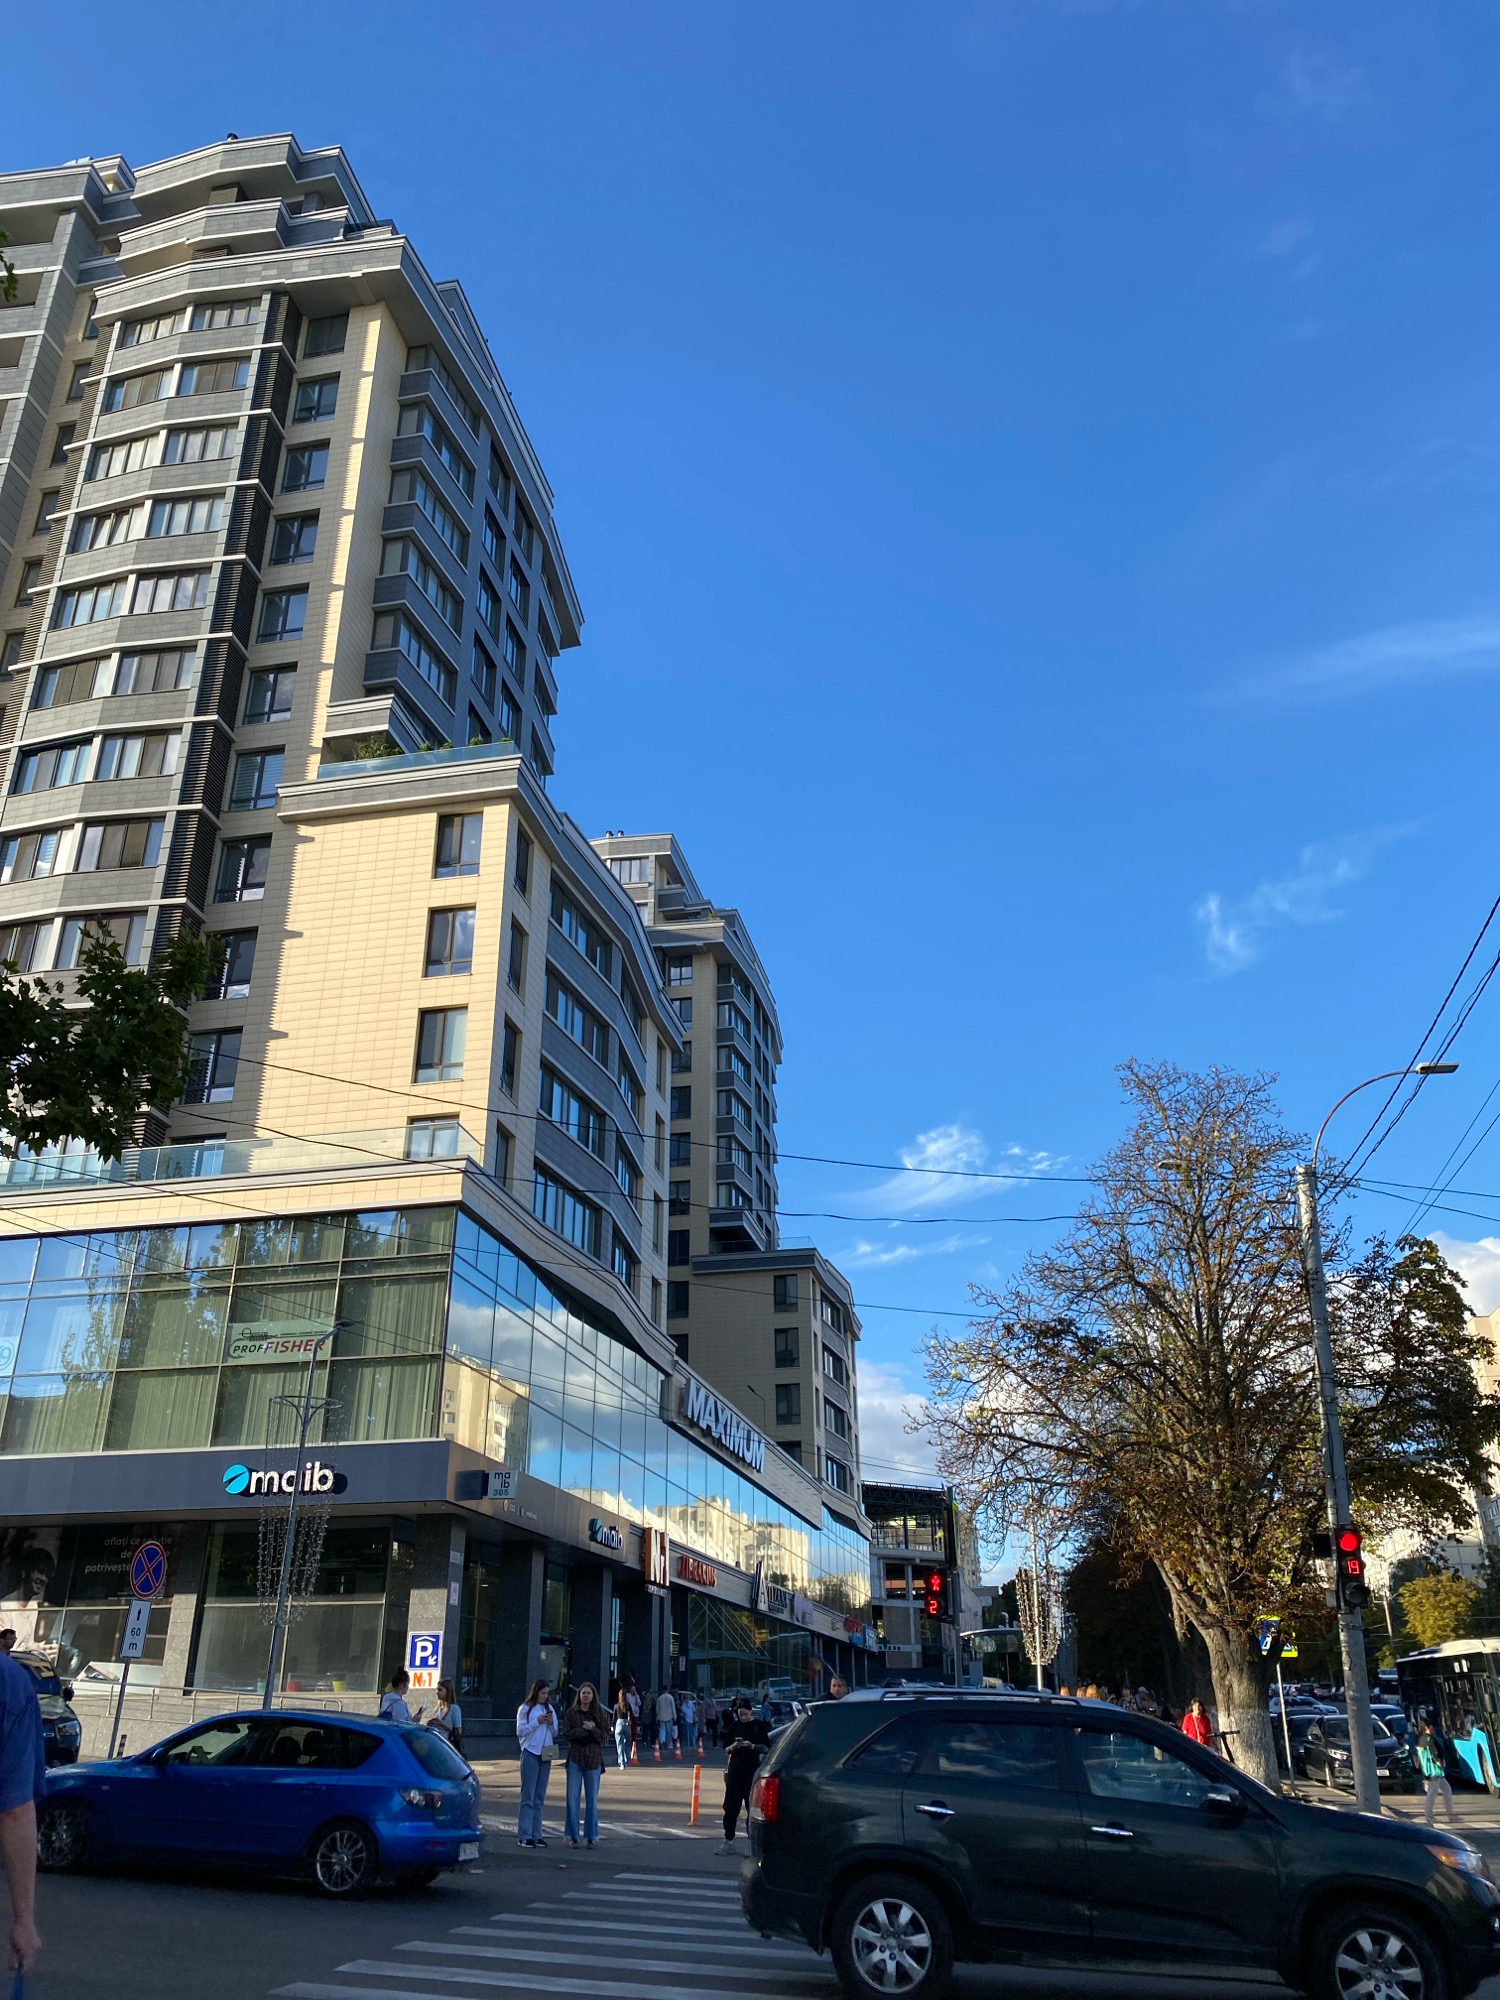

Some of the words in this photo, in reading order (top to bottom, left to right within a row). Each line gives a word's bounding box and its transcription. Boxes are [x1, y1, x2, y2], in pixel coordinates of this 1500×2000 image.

[686, 1378, 766, 1473] MAXIMUM
[249, 1461, 334, 1493] maib
[494, 1471, 511, 1479] ma
[500, 1479, 510, 1488] ib
[121, 1549, 132, 1558] de
[1347, 1560, 1360, 1574] 19
[930, 1600, 938, 1614] 2
[130, 1627, 141, 1637] 60
[128, 1642, 137, 1650] m
[415, 1641, 433, 1666] P
